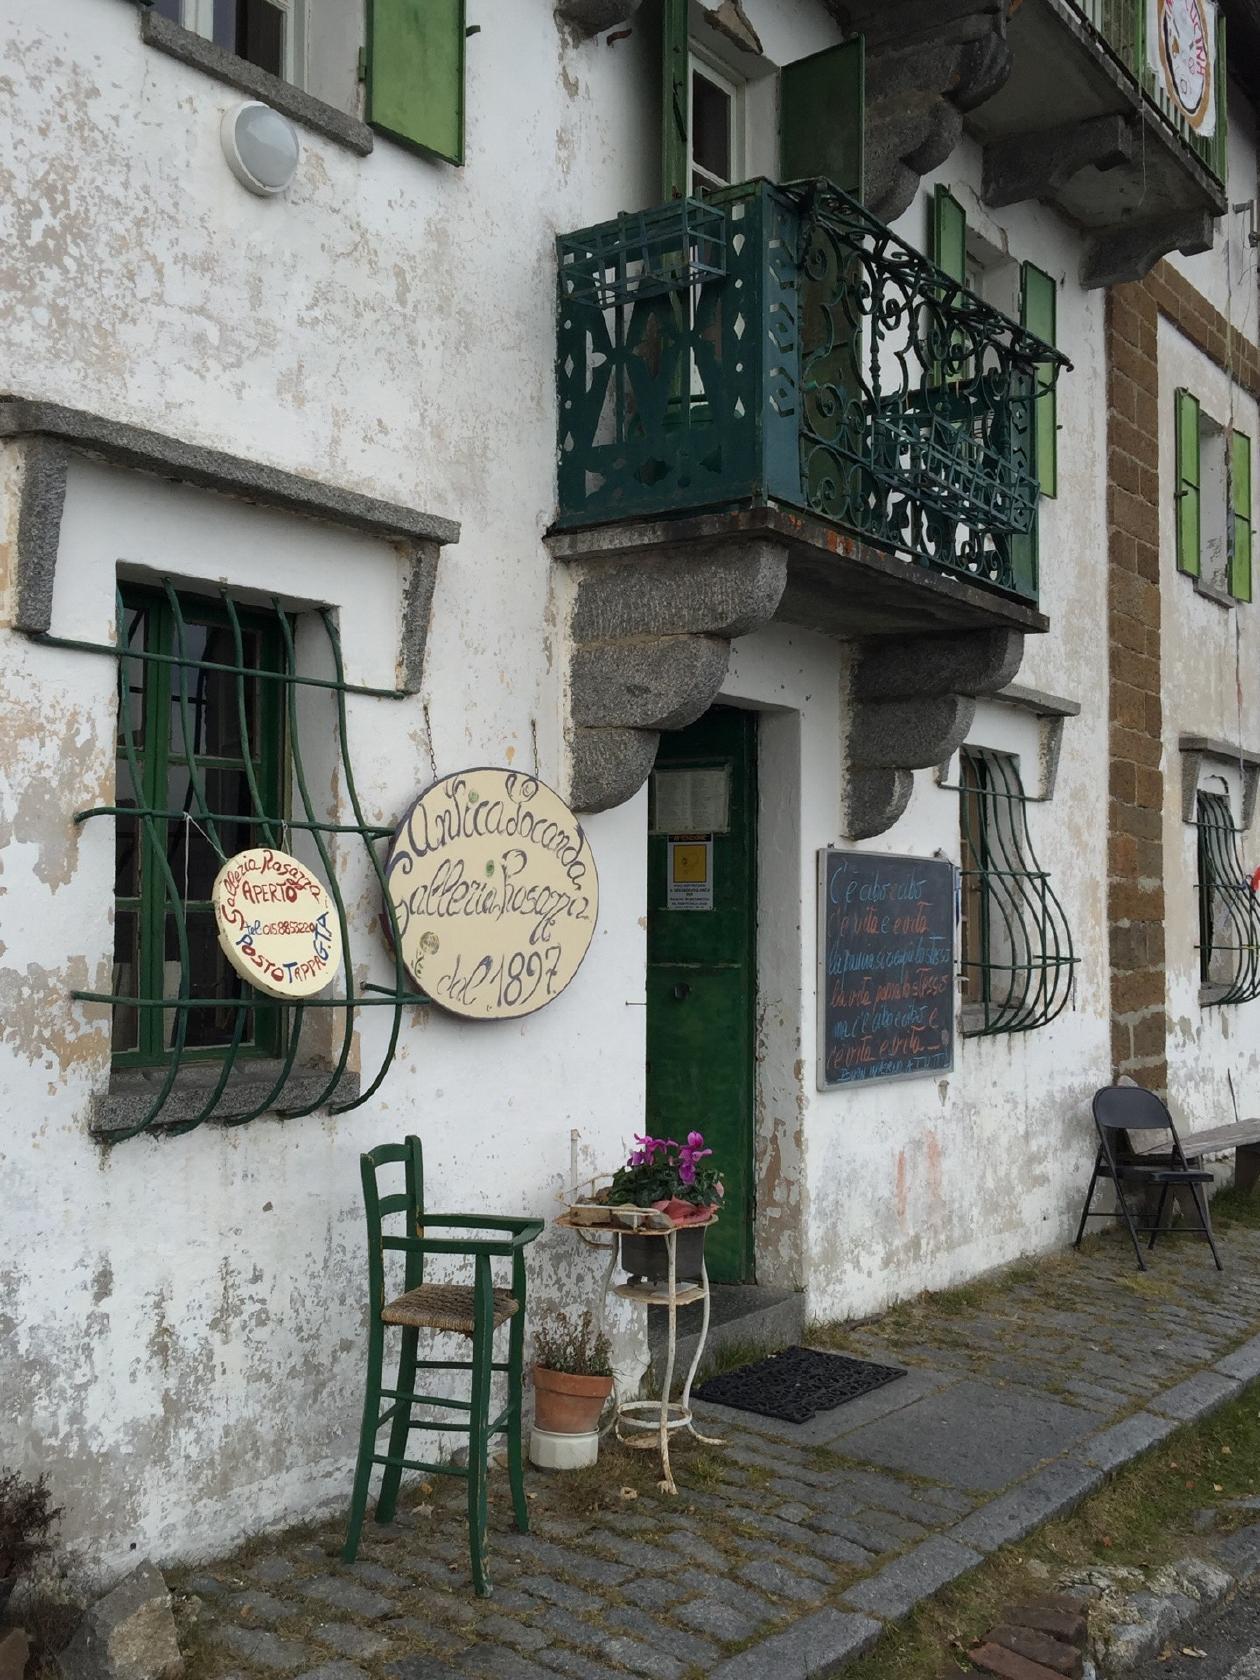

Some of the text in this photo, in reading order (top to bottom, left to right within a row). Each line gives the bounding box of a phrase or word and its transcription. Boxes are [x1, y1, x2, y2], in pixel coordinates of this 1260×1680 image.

[242, 880, 298, 904] APERTO
[236, 934, 285, 982] POSTO
[283, 956, 327, 984] TAPPA
[437, 953, 493, 1006] dal
